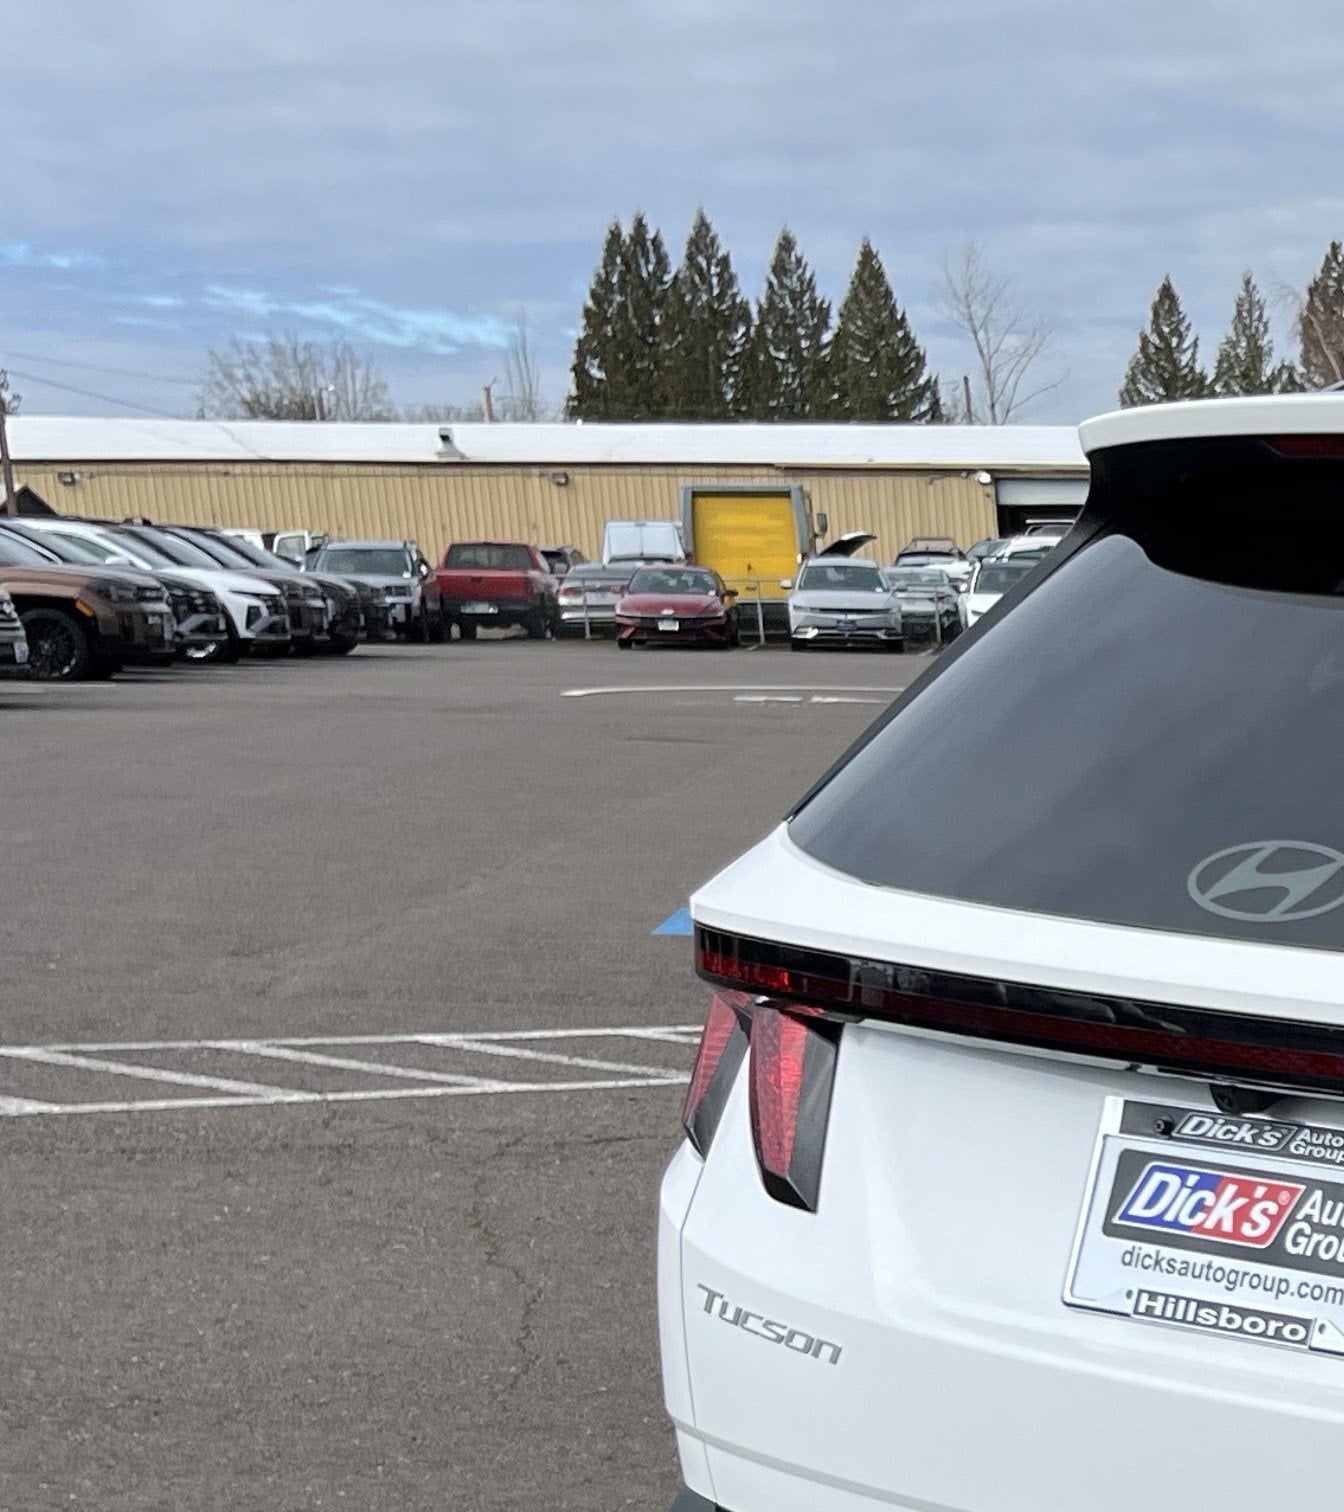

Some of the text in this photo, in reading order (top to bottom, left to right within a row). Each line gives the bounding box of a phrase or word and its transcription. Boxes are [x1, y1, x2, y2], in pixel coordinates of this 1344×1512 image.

[1180, 1116, 1283, 1147] Dick's
[1295, 1127, 1344, 1147] Auto
[1127, 1171, 1280, 1239] Dick's
[1136, 1291, 1308, 1342] Hillsboro
